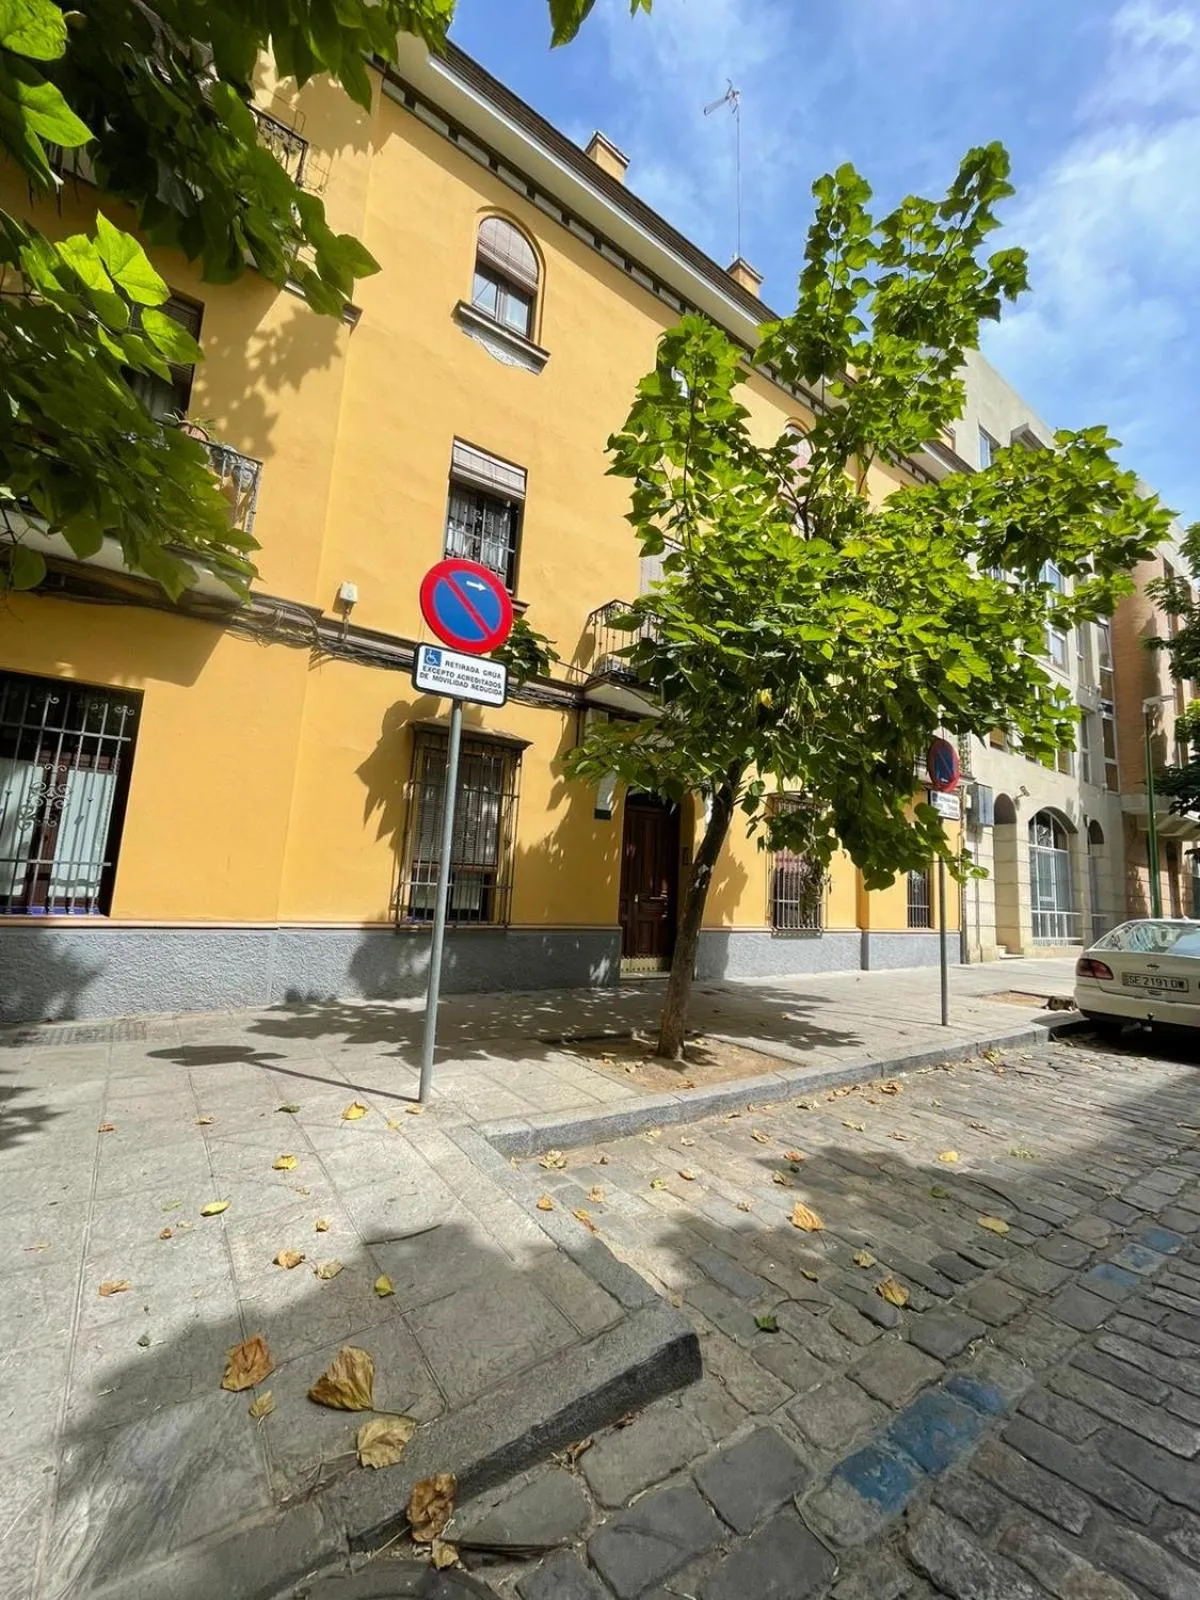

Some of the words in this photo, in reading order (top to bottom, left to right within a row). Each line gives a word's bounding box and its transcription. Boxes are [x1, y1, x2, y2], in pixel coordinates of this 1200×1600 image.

[445, 660, 479, 674] RETIRADA
[420, 672, 429, 680] DE
[432, 675, 468, 688] MOVILIDAD
[471, 684, 502, 695] REDUCIDA
[423, 665, 455, 678] EXCEPTO
[457, 674, 501, 688] ACREDITADOS
[1142, 976, 1168, 987] 2191
